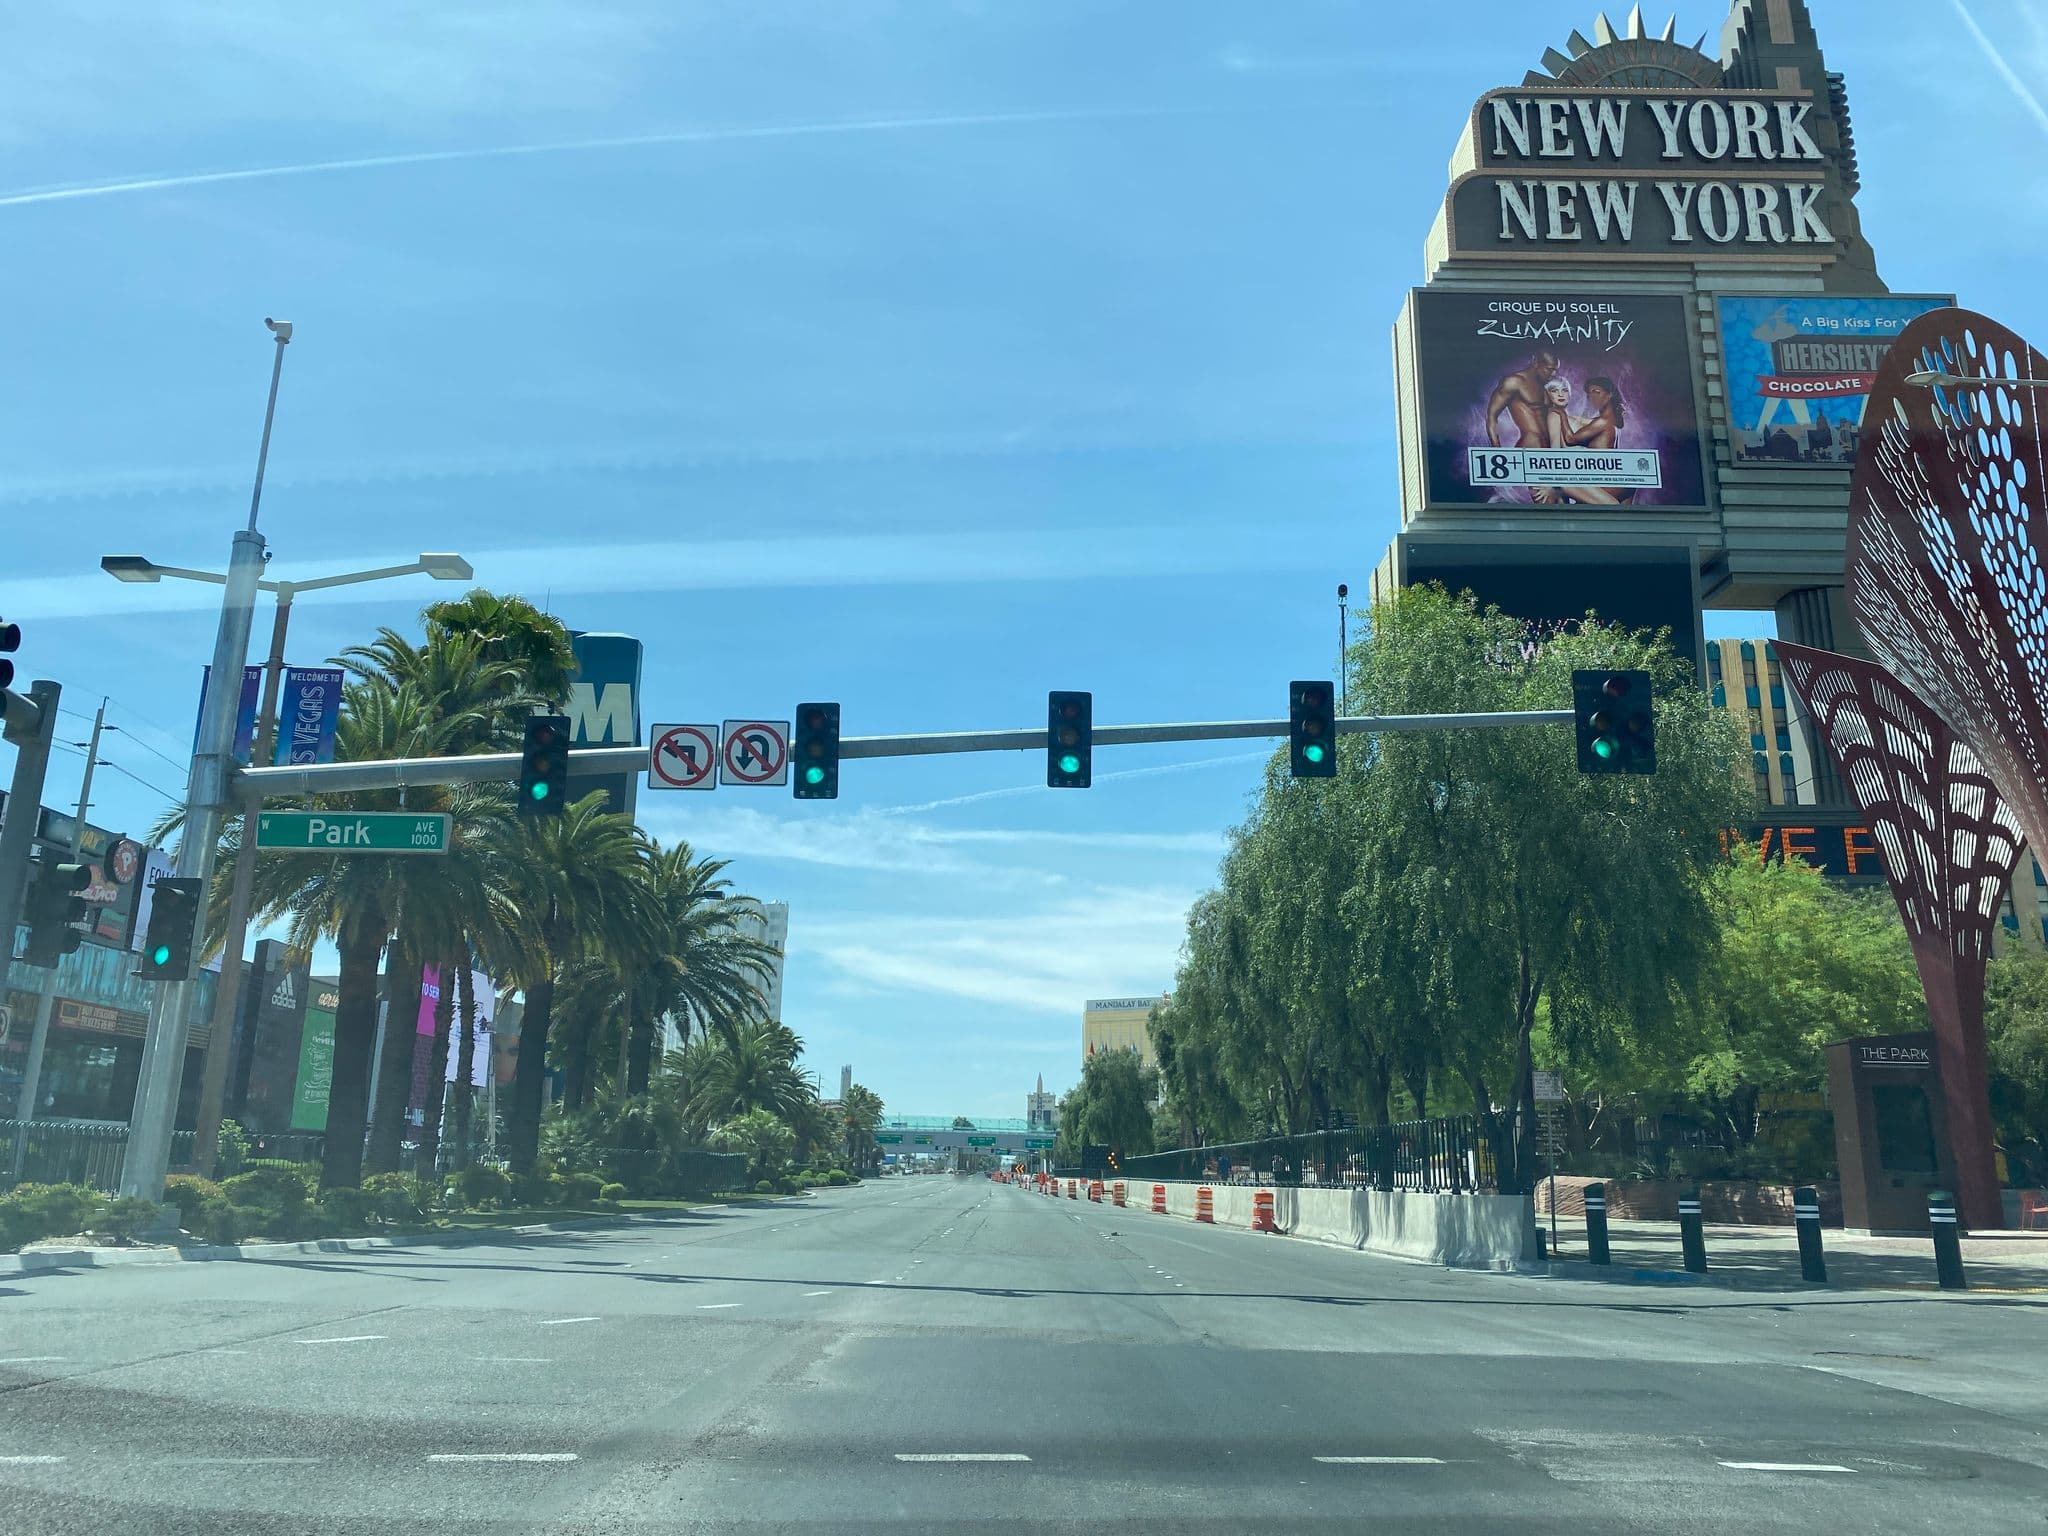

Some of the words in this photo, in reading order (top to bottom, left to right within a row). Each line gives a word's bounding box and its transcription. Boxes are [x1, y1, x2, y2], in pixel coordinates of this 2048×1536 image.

[1488, 97, 1631, 158] NEW
[1647, 98, 1825, 160] YORK
[1494, 179, 1640, 242] NEW
[1655, 180, 1837, 244] YORK
[1488, 301, 1542, 316] CIRQUE
[1545, 302, 1567, 313] DU
[1570, 303, 1621, 314] SOLEIL
[1801, 317, 1813, 327] A
[1816, 317, 1839, 329] Big
[1843, 317, 1871, 328] Kiss
[1875, 318, 1897, 328] For
[1767, 377, 1863, 394] CHOCOLATE
[1474, 453, 1523, 479] 18+
[1529, 457, 1571, 470] RATED
[1575, 457, 1623, 471] CIRQUE
[248, 672, 258, 680] TO
[290, 671, 328, 682] WELCOME
[330, 673, 340, 683] TO
[292, 685, 325, 745] VEGAS
[261, 819, 270, 831] W
[307, 818, 372, 845] Park
[414, 821, 436, 834] AVE
[411, 833, 438, 846] 1000
[271, 994, 297, 1010] adidas
[1095, 1000, 1137, 1009] MANDALAY
[1137, 999, 1152, 1008] BAY
[1860, 1047, 1887, 1060] THE
[1890, 1047, 1930, 1061] PARK
